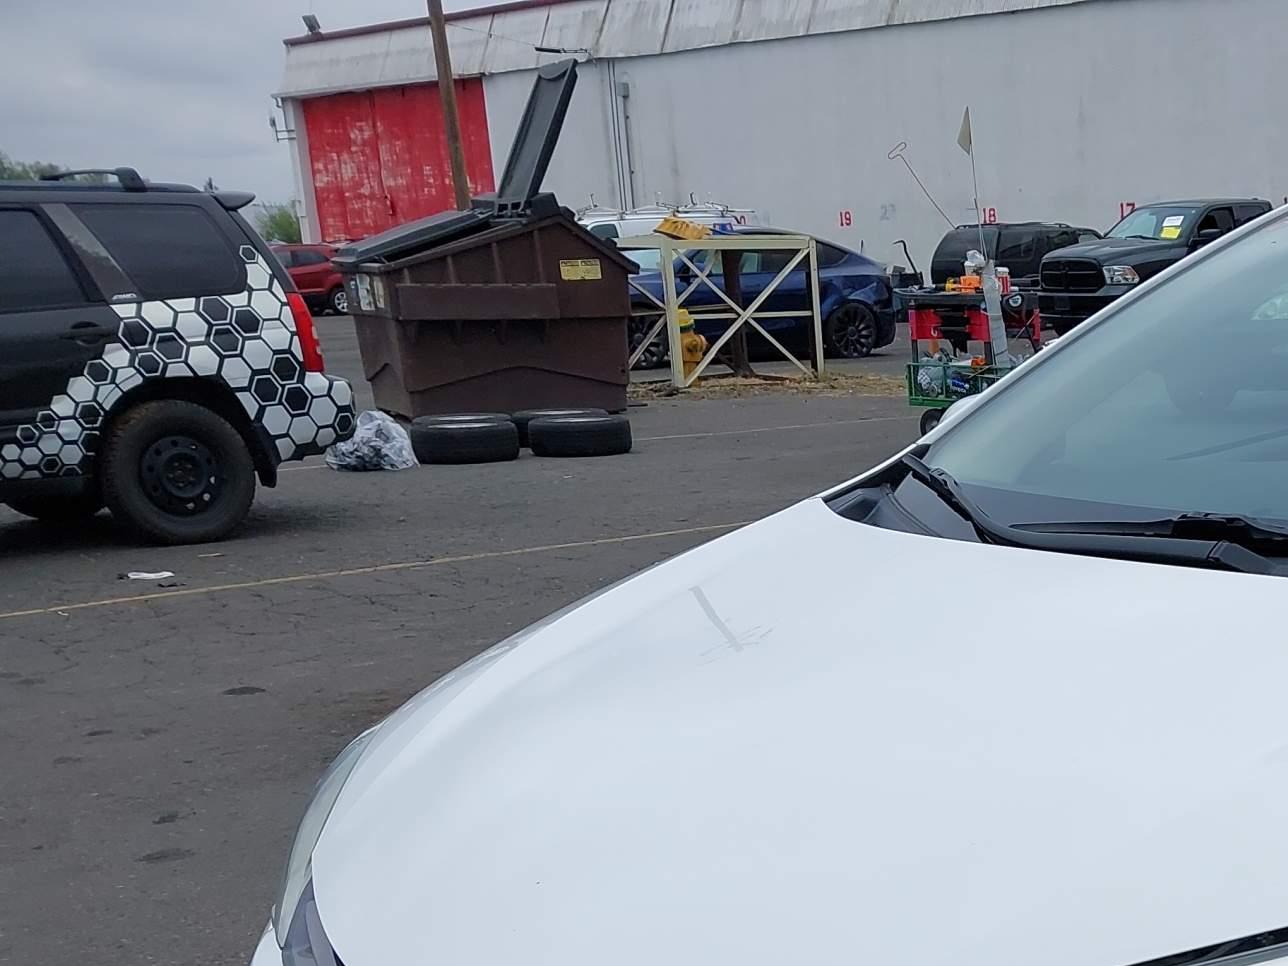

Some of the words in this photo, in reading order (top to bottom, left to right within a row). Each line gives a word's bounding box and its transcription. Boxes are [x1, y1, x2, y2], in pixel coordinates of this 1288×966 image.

[982, 208, 997, 224] 18
[1120, 202, 1136, 219] 17
[839, 211, 852, 227] 19
